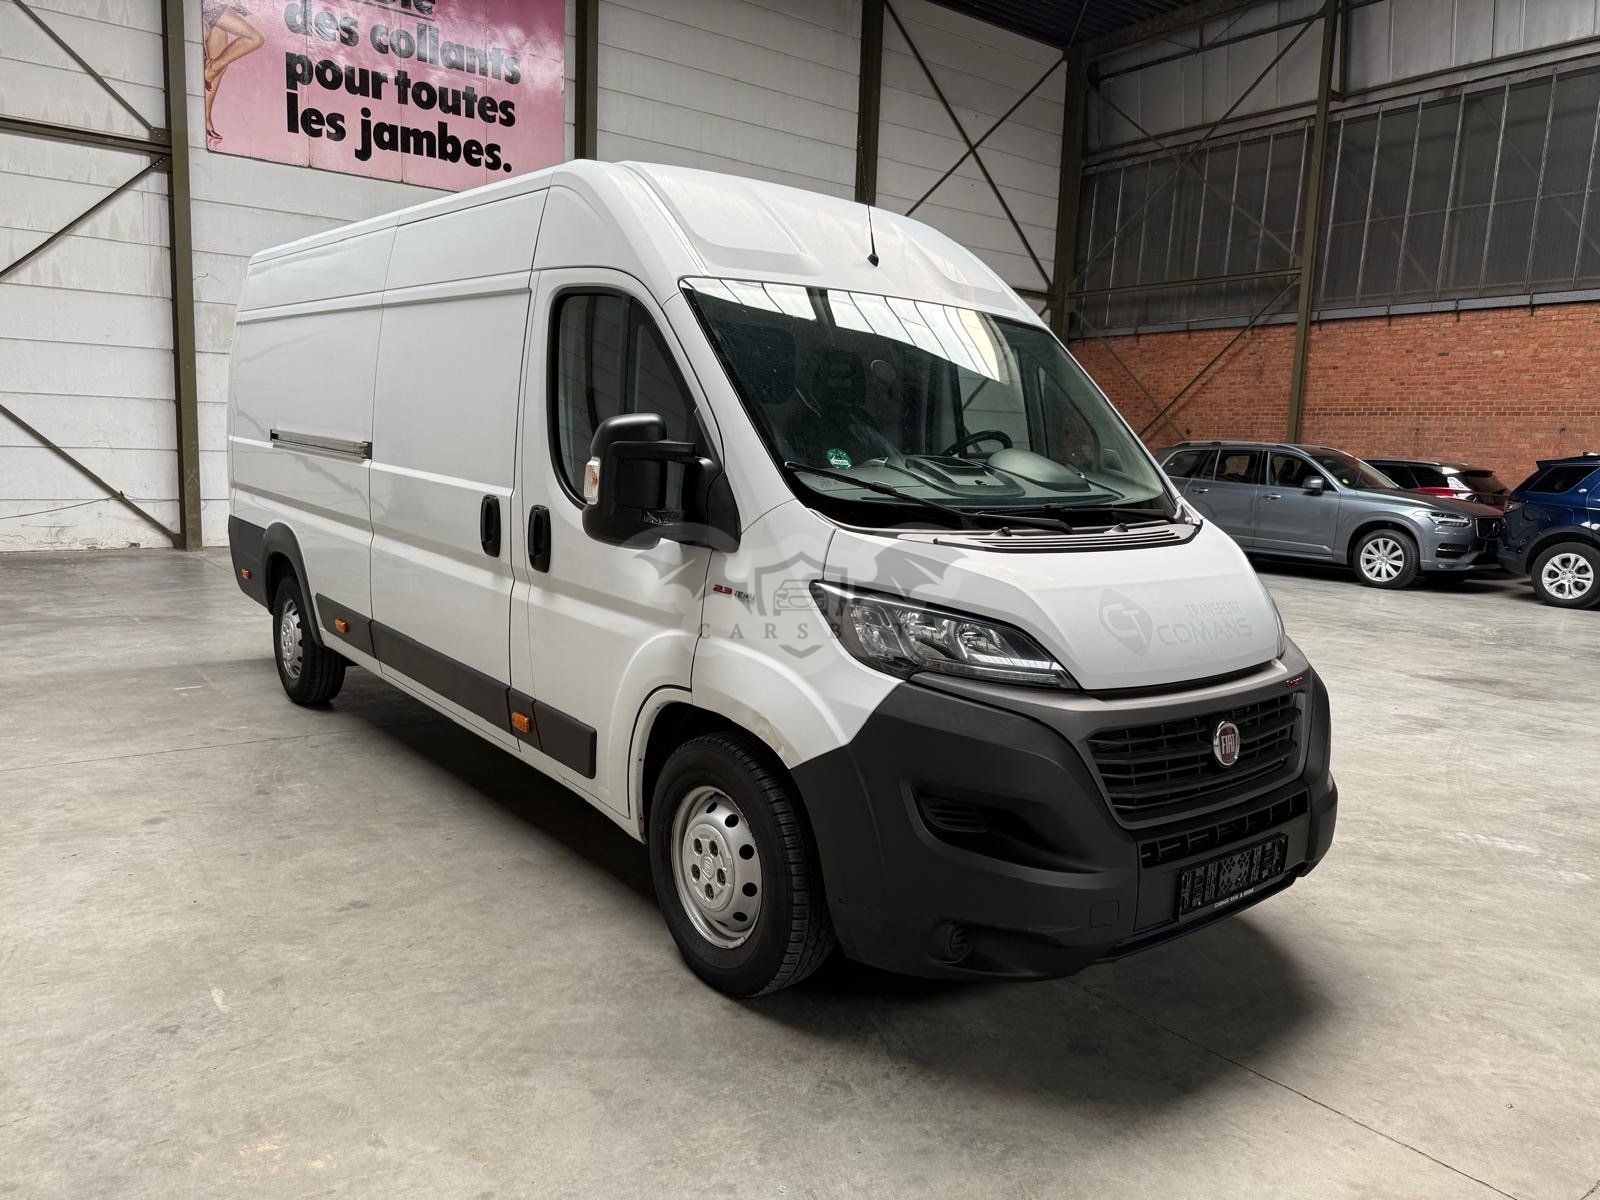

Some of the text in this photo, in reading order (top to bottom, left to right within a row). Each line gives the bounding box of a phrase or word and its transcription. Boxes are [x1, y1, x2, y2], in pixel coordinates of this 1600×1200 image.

[284, 0, 521, 85] des collants
[286, 52, 516, 127] pour toutes
[286, 91, 512, 173] les jambes.
[1157, 618, 1252, 645] COMANS
[1184, 600, 1243, 617] TRANSPORT
[1221, 733, 1237, 755] FIAT
